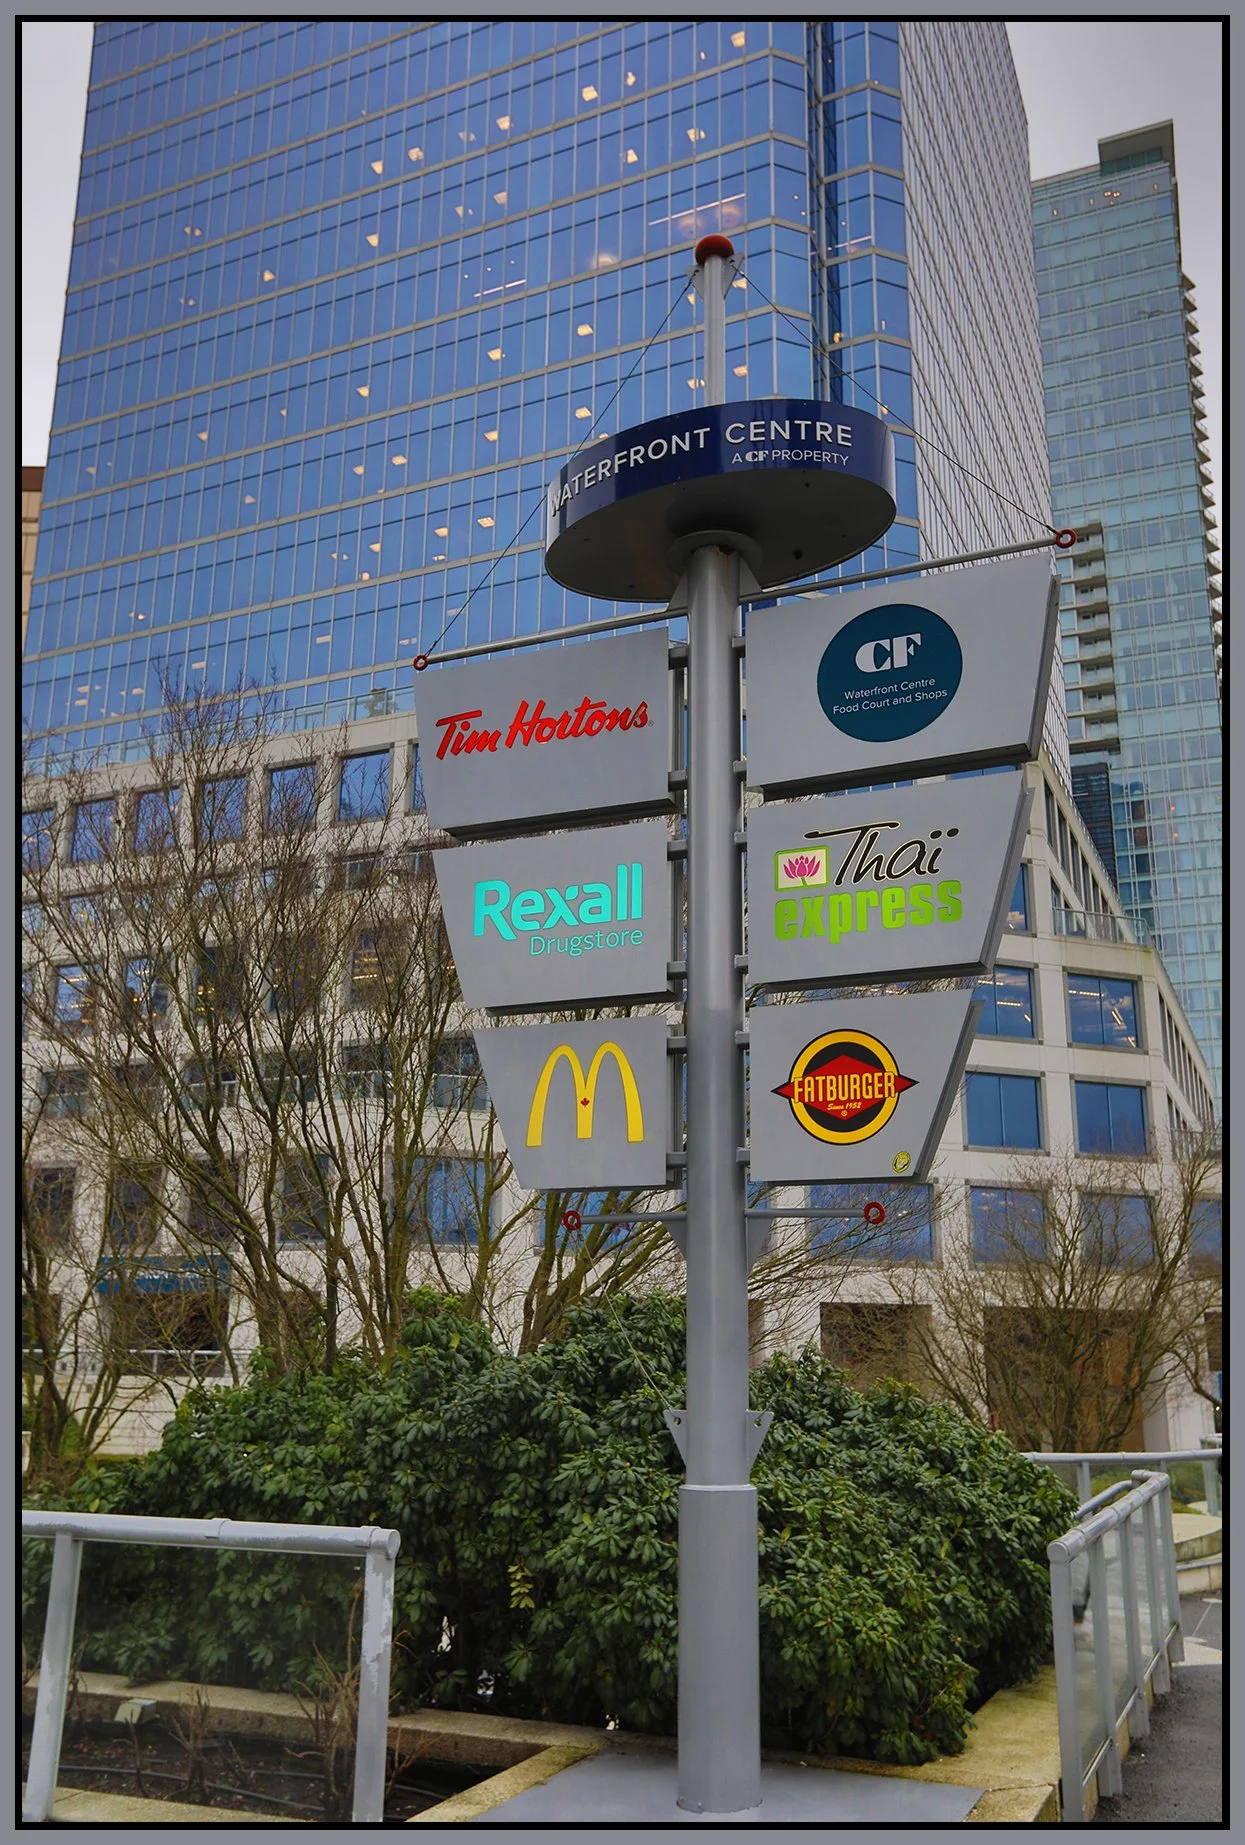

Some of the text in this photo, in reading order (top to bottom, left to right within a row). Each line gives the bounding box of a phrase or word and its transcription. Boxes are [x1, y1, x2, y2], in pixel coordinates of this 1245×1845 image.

[550, 420, 852, 516] WATERFRONT CENTRE
[731, 449, 849, 466] A CF PROPERTY
[855, 633, 922, 673] CF
[833, 690, 948, 714] Food Court and Shops
[844, 678, 936, 700] Waterfront Centre
[436, 697, 648, 760] Tim Hortons
[472, 862, 644, 941] Rexall
[774, 880, 963, 944] express
[530, 929, 644, 957] Drugstore
[793, 1071, 896, 1104] FATBURGER
